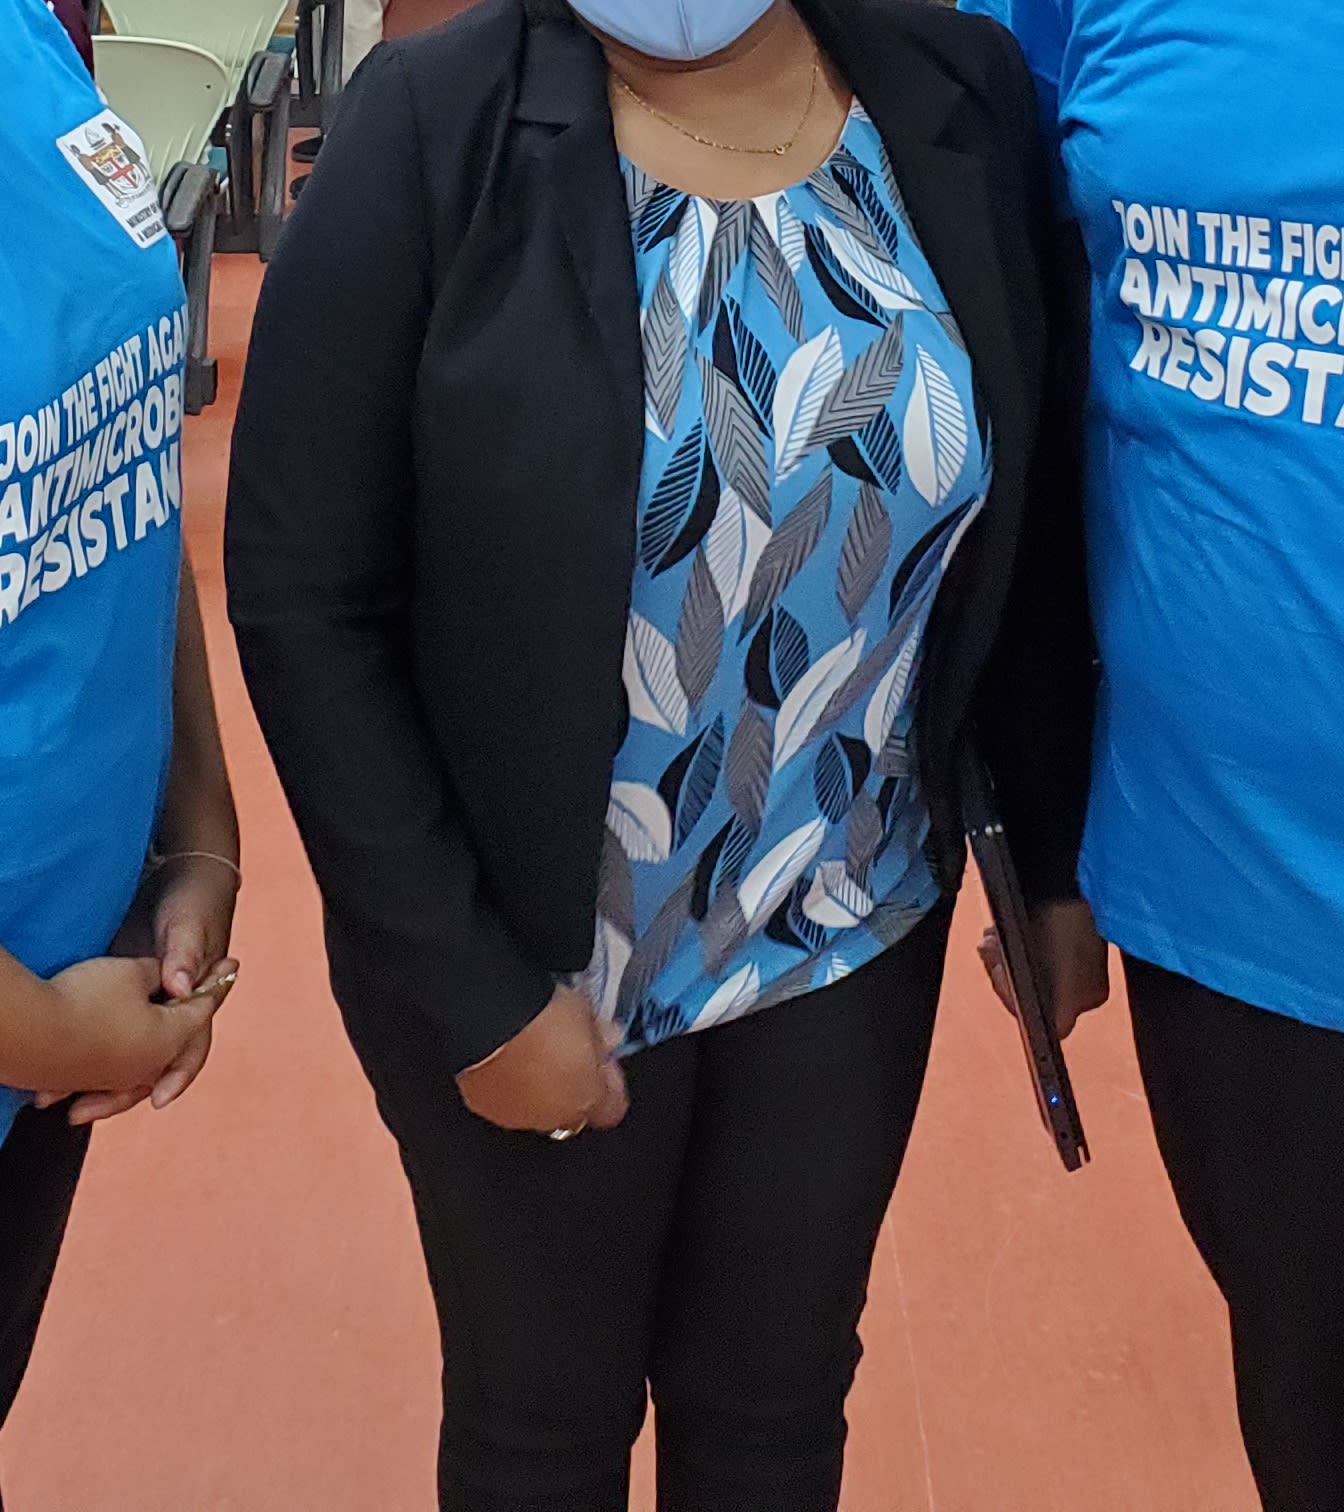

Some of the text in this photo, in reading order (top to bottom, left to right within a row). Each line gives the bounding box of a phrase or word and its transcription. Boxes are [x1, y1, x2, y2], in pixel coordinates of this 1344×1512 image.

[1196, 211, 1272, 270] THE
[62, 372, 99, 446] THE
[95, 334, 145, 420] FIGHT
